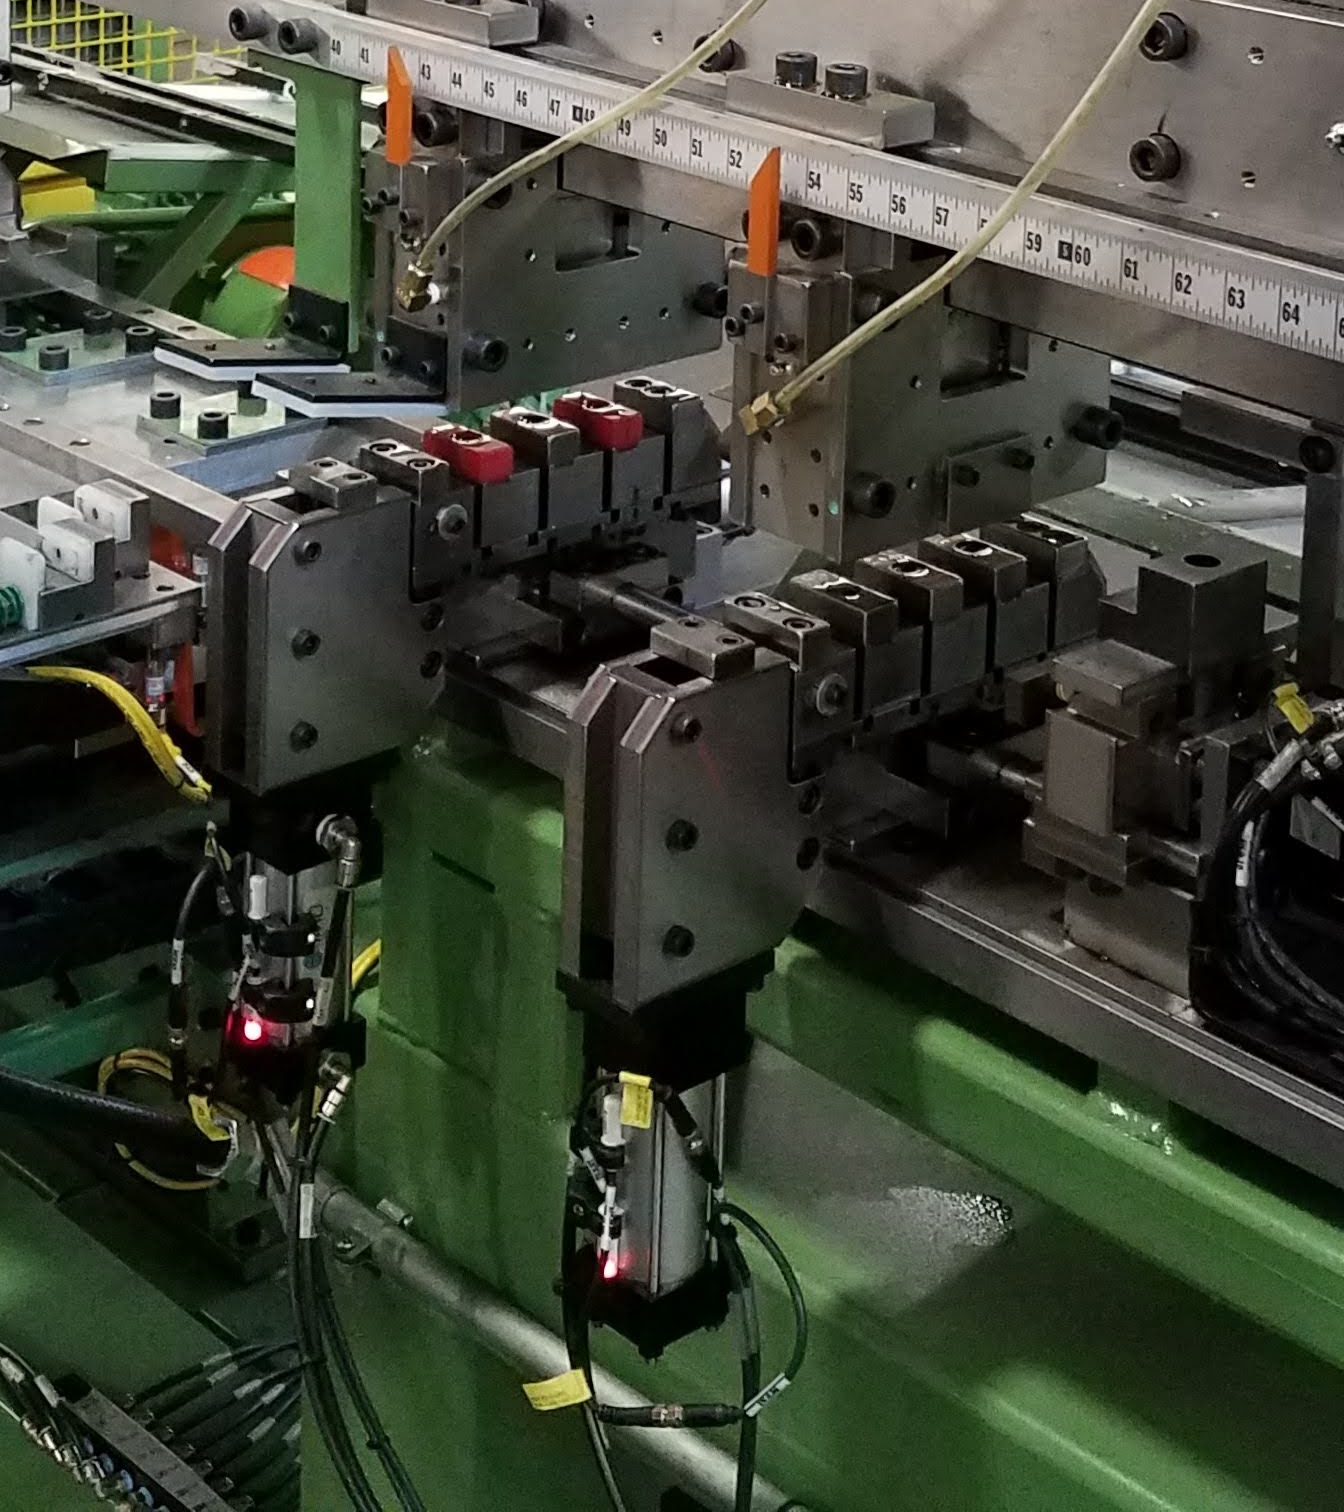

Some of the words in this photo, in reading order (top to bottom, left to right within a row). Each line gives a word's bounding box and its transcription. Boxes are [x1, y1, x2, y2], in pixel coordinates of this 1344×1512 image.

[331, 39, 341, 55] 40
[360, 47, 369, 64] 41
[421, 63, 431, 80] 43
[452, 72, 462, 89] 44
[484, 80, 494, 98] 45
[516, 90, 527, 107] 46
[549, 99, 560, 116] 47
[618, 118, 631, 136] 49
[654, 128, 667, 147] 50
[691, 138, 703, 158] 51
[729, 149, 742, 168] 52
[807, 171, 821, 191] 54
[848, 182, 863, 203] 55
[891, 194, 906, 215] 56
[935, 206, 949, 227] 57
[1026, 231, 1042, 253] 59
[1074, 245, 1091, 266] 60
[1124, 258, 1139, 281] 61
[1175, 272, 1192, 295] 62
[1227, 286, 1245, 309] 63
[1282, 301, 1300, 325] 64
